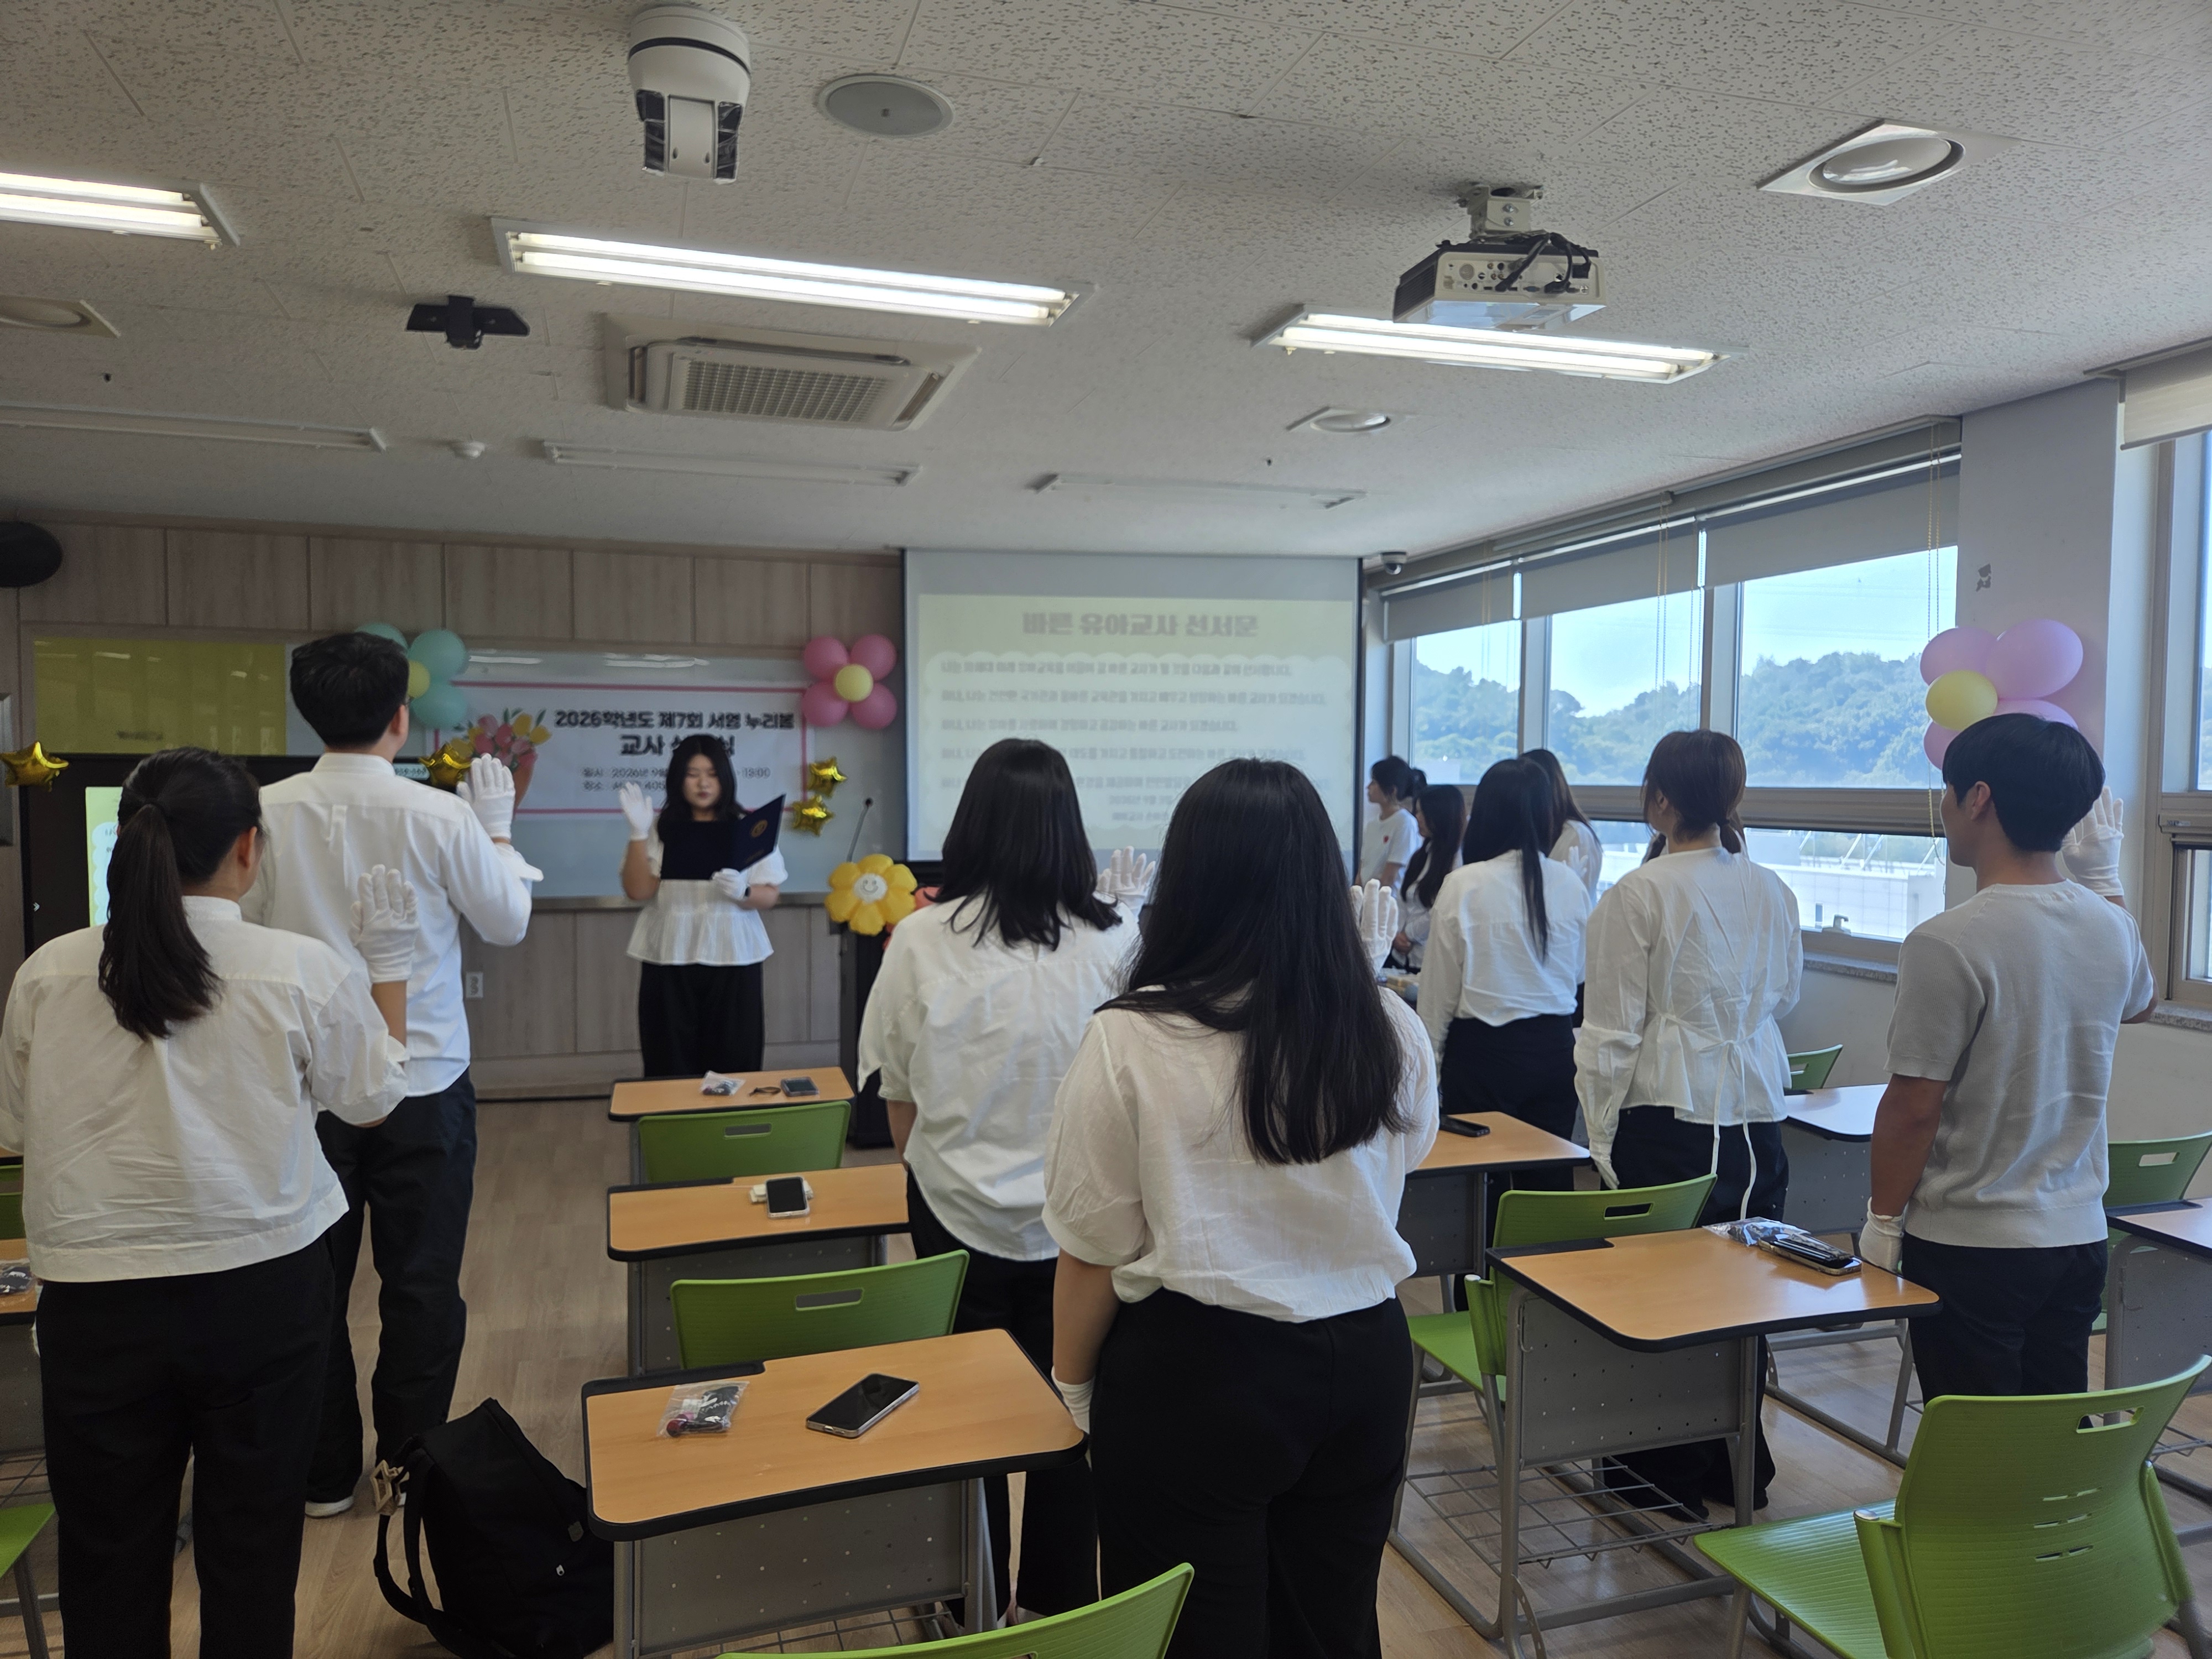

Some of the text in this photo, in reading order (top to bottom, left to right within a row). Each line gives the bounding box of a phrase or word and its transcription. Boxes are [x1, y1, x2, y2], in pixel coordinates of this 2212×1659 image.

[1022, 612, 1259, 638] 바른 유아교사 선서문
[555, 710, 655, 729] 2026학년도
[658, 711, 704, 729] 제7회
[708, 712, 741, 729] 서영
[619, 734, 666, 755] 교사
